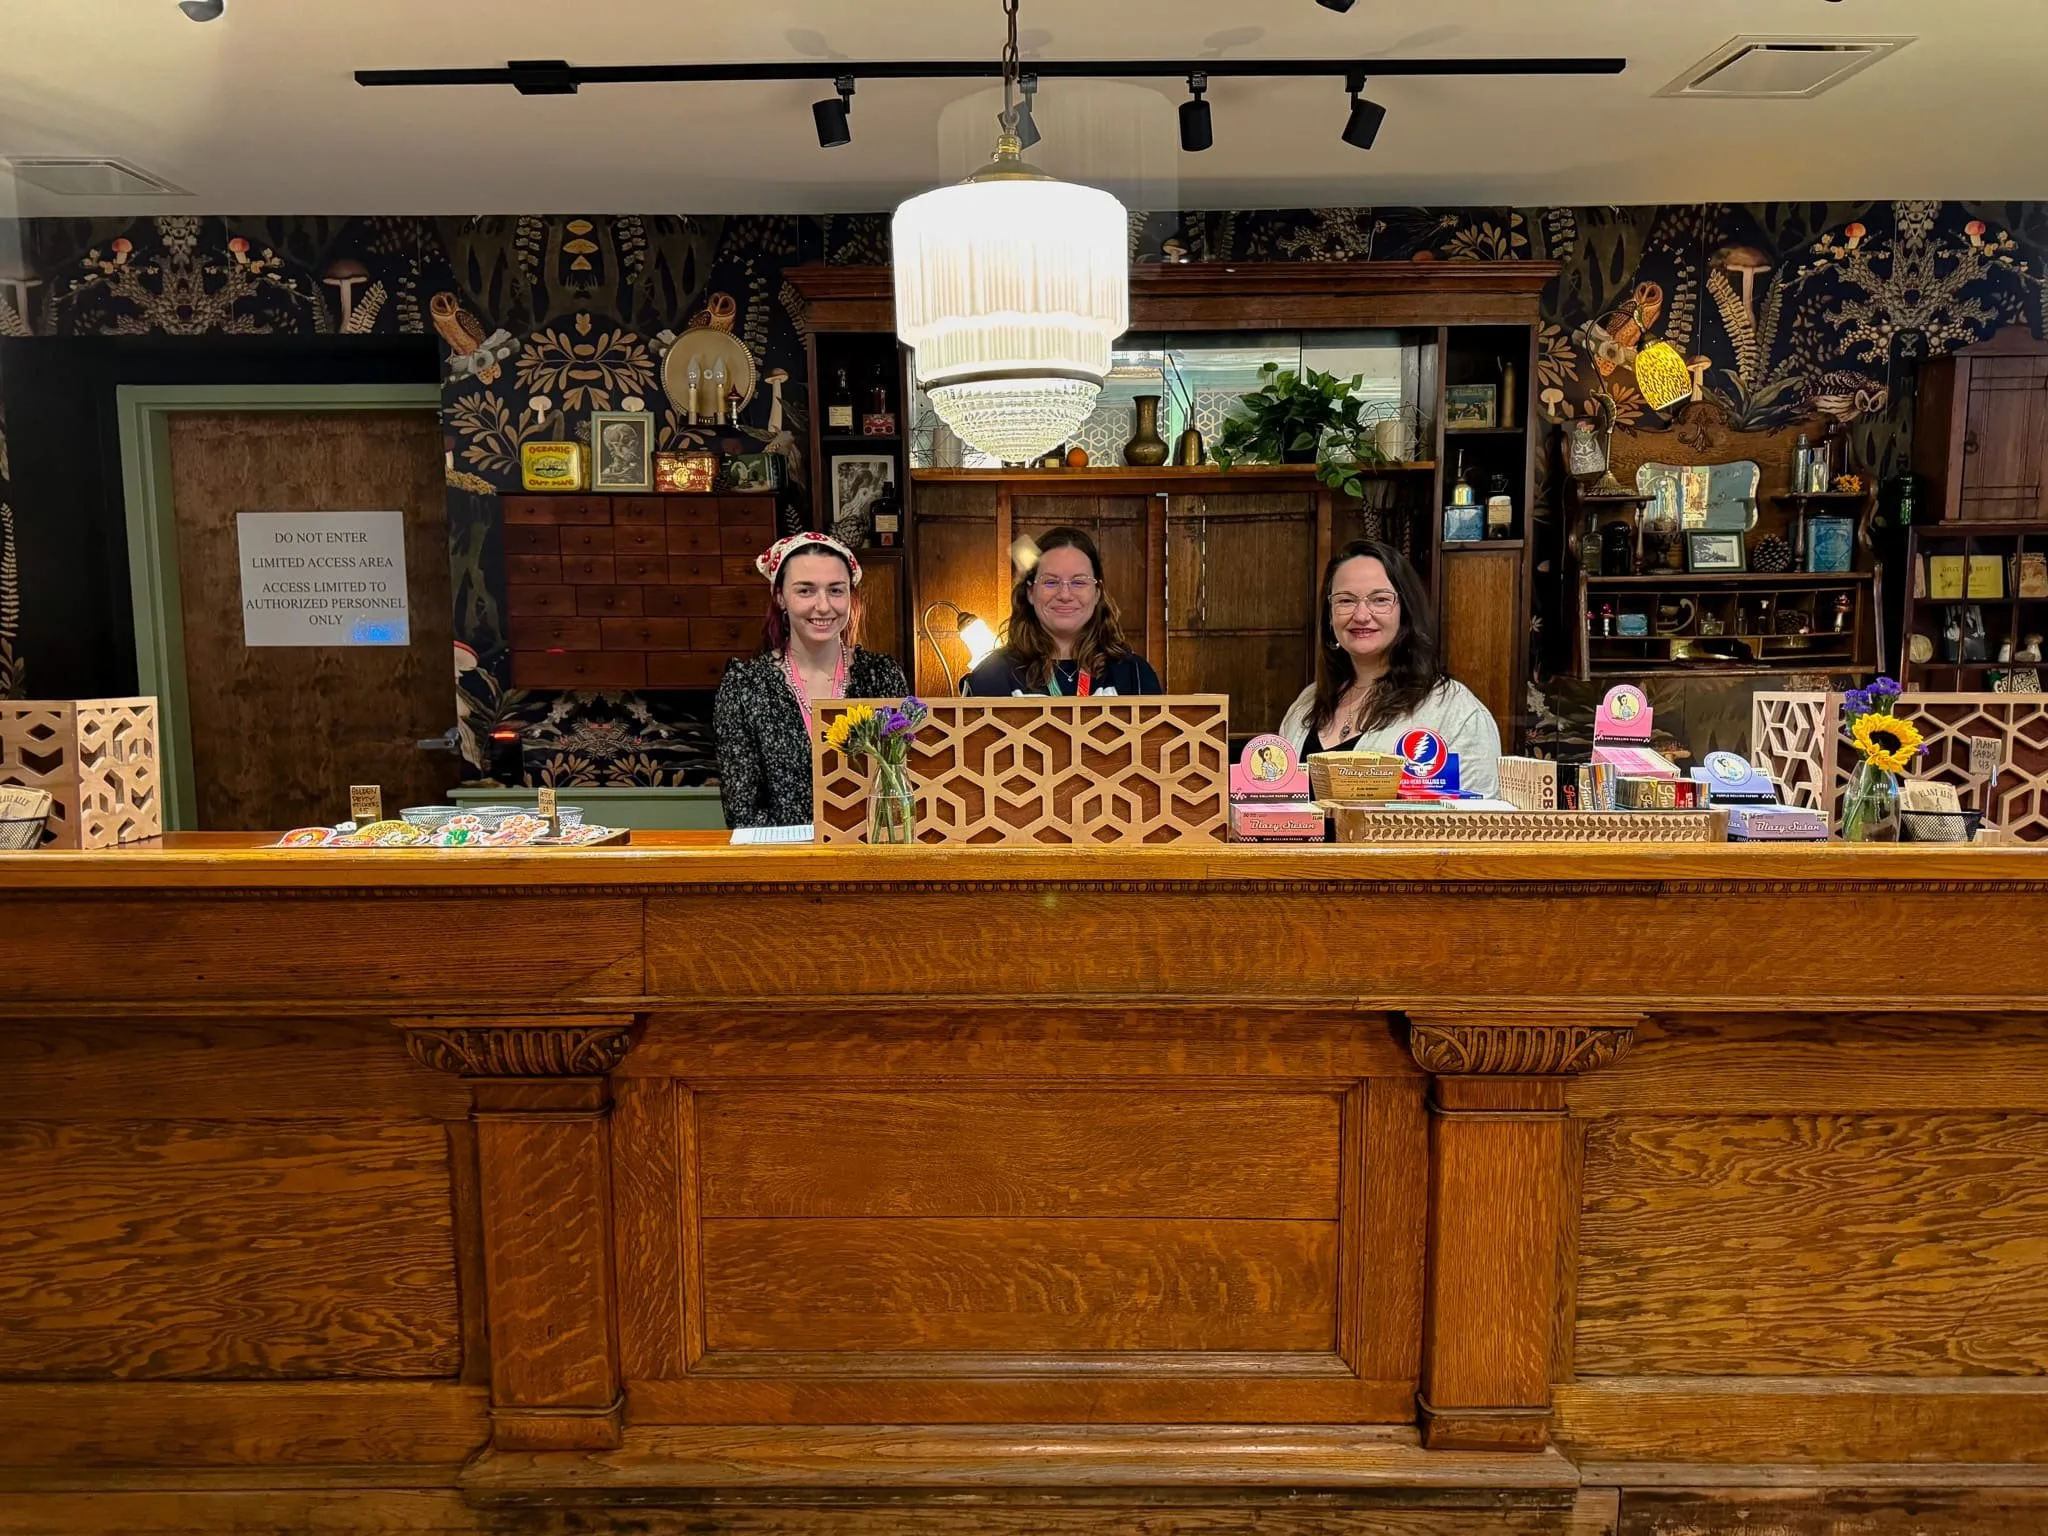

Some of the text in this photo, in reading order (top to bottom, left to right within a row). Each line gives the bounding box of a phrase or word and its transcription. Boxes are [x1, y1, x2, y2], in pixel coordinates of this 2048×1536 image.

[528, 446, 571, 455] OCEANIC
[274, 532, 368, 544] DO NOT ENTER
[251, 557, 393, 569] LIMITED ACCESS AREA
[262, 581, 387, 593] ACCESS LIMITED TO
[246, 598, 406, 610] AUTHORIZED PERSONNEL
[308, 615, 344, 626] ONLY
[1975, 738, 2000, 750] PLANT
[1972, 750, 1997, 760] CARDS
[1338, 767, 1394, 777] Blazy Susan
[1542, 774, 1554, 810] OCB
[1250, 820, 1316, 832] Blazy Susan
[1756, 821, 1820, 833] Blazy Susan
